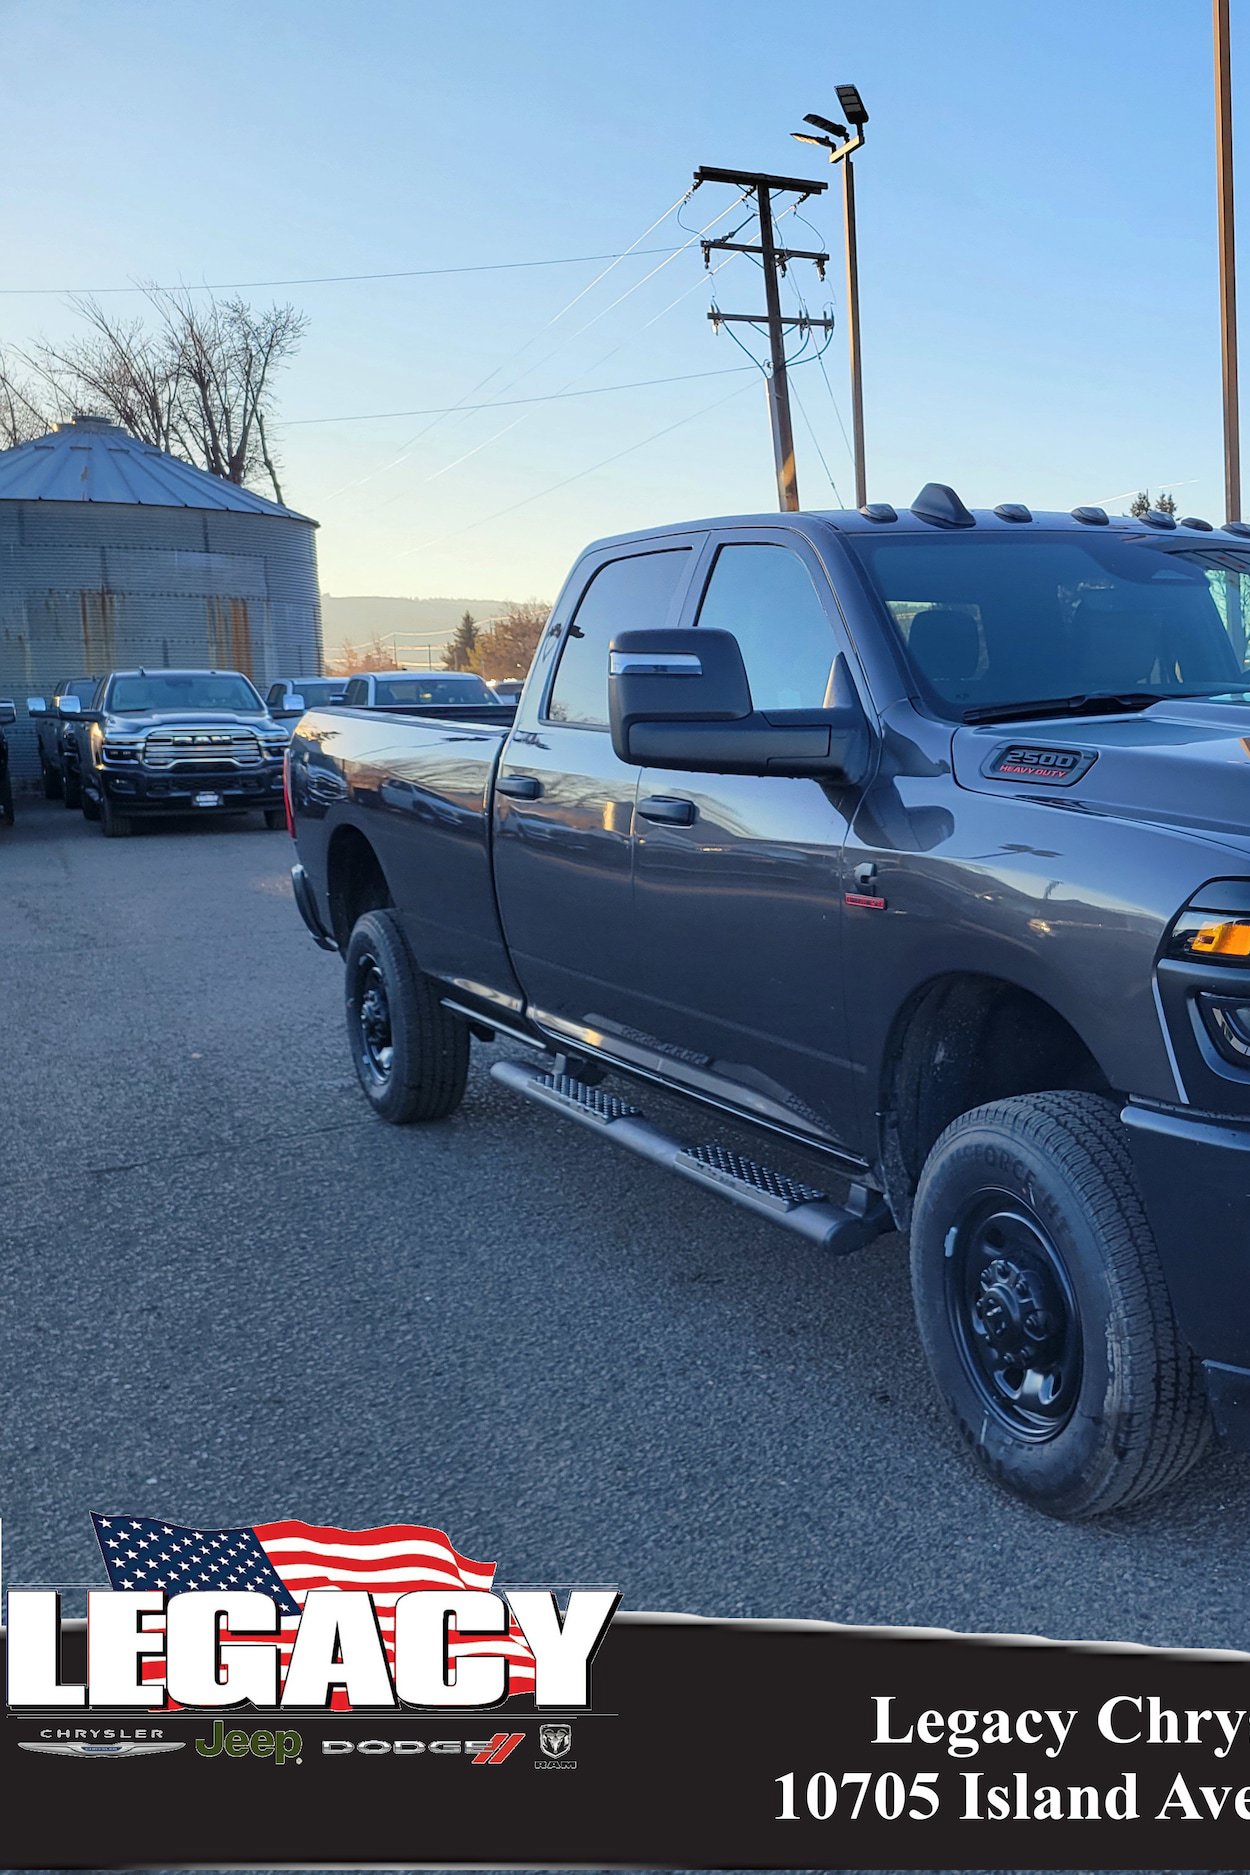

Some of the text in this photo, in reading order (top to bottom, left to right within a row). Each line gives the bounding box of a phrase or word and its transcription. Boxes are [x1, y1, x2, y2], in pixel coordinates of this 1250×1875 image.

[1004, 750, 1076, 769] 2500
[1000, 765, 1067, 778] HEAVY DUTY
